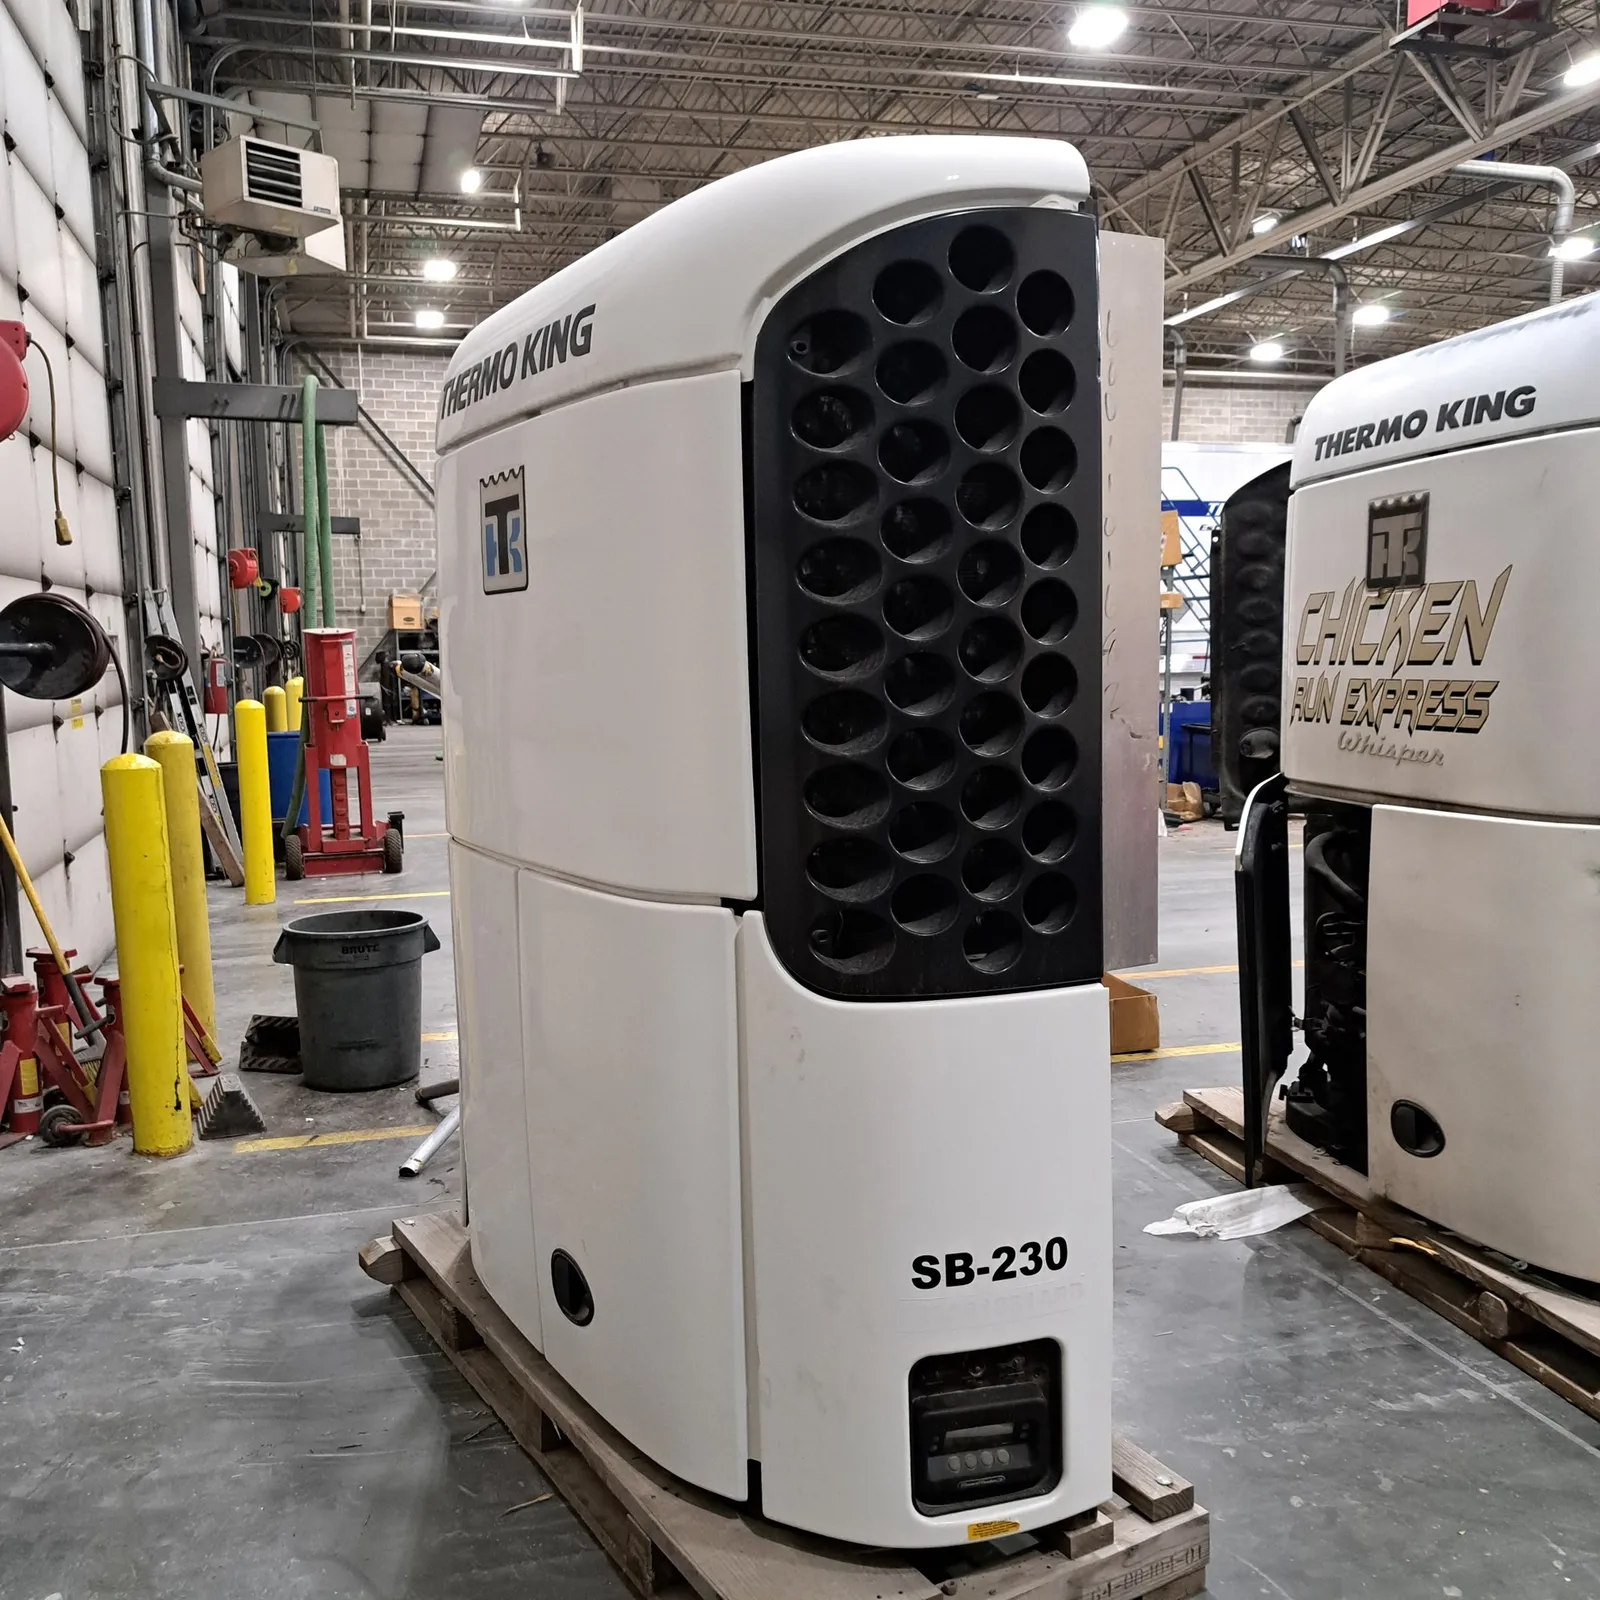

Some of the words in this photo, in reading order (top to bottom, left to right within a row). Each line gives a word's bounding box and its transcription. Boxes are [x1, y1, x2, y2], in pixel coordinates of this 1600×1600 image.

[441, 342, 519, 420] THERMO
[521, 303, 597, 379] KING
[1315, 409, 1428, 461] THERMO
[1436, 385, 1537, 432] KING
[1296, 564, 1513, 678] CHICKEN
[1290, 669, 1341, 726] RUN
[1340, 678, 1500, 737] EXPRESS
[1337, 730, 1444, 766] Whisper
[341, 944, 381, 955] BRUTE
[911, 1236, 1068, 1290] SB-230
